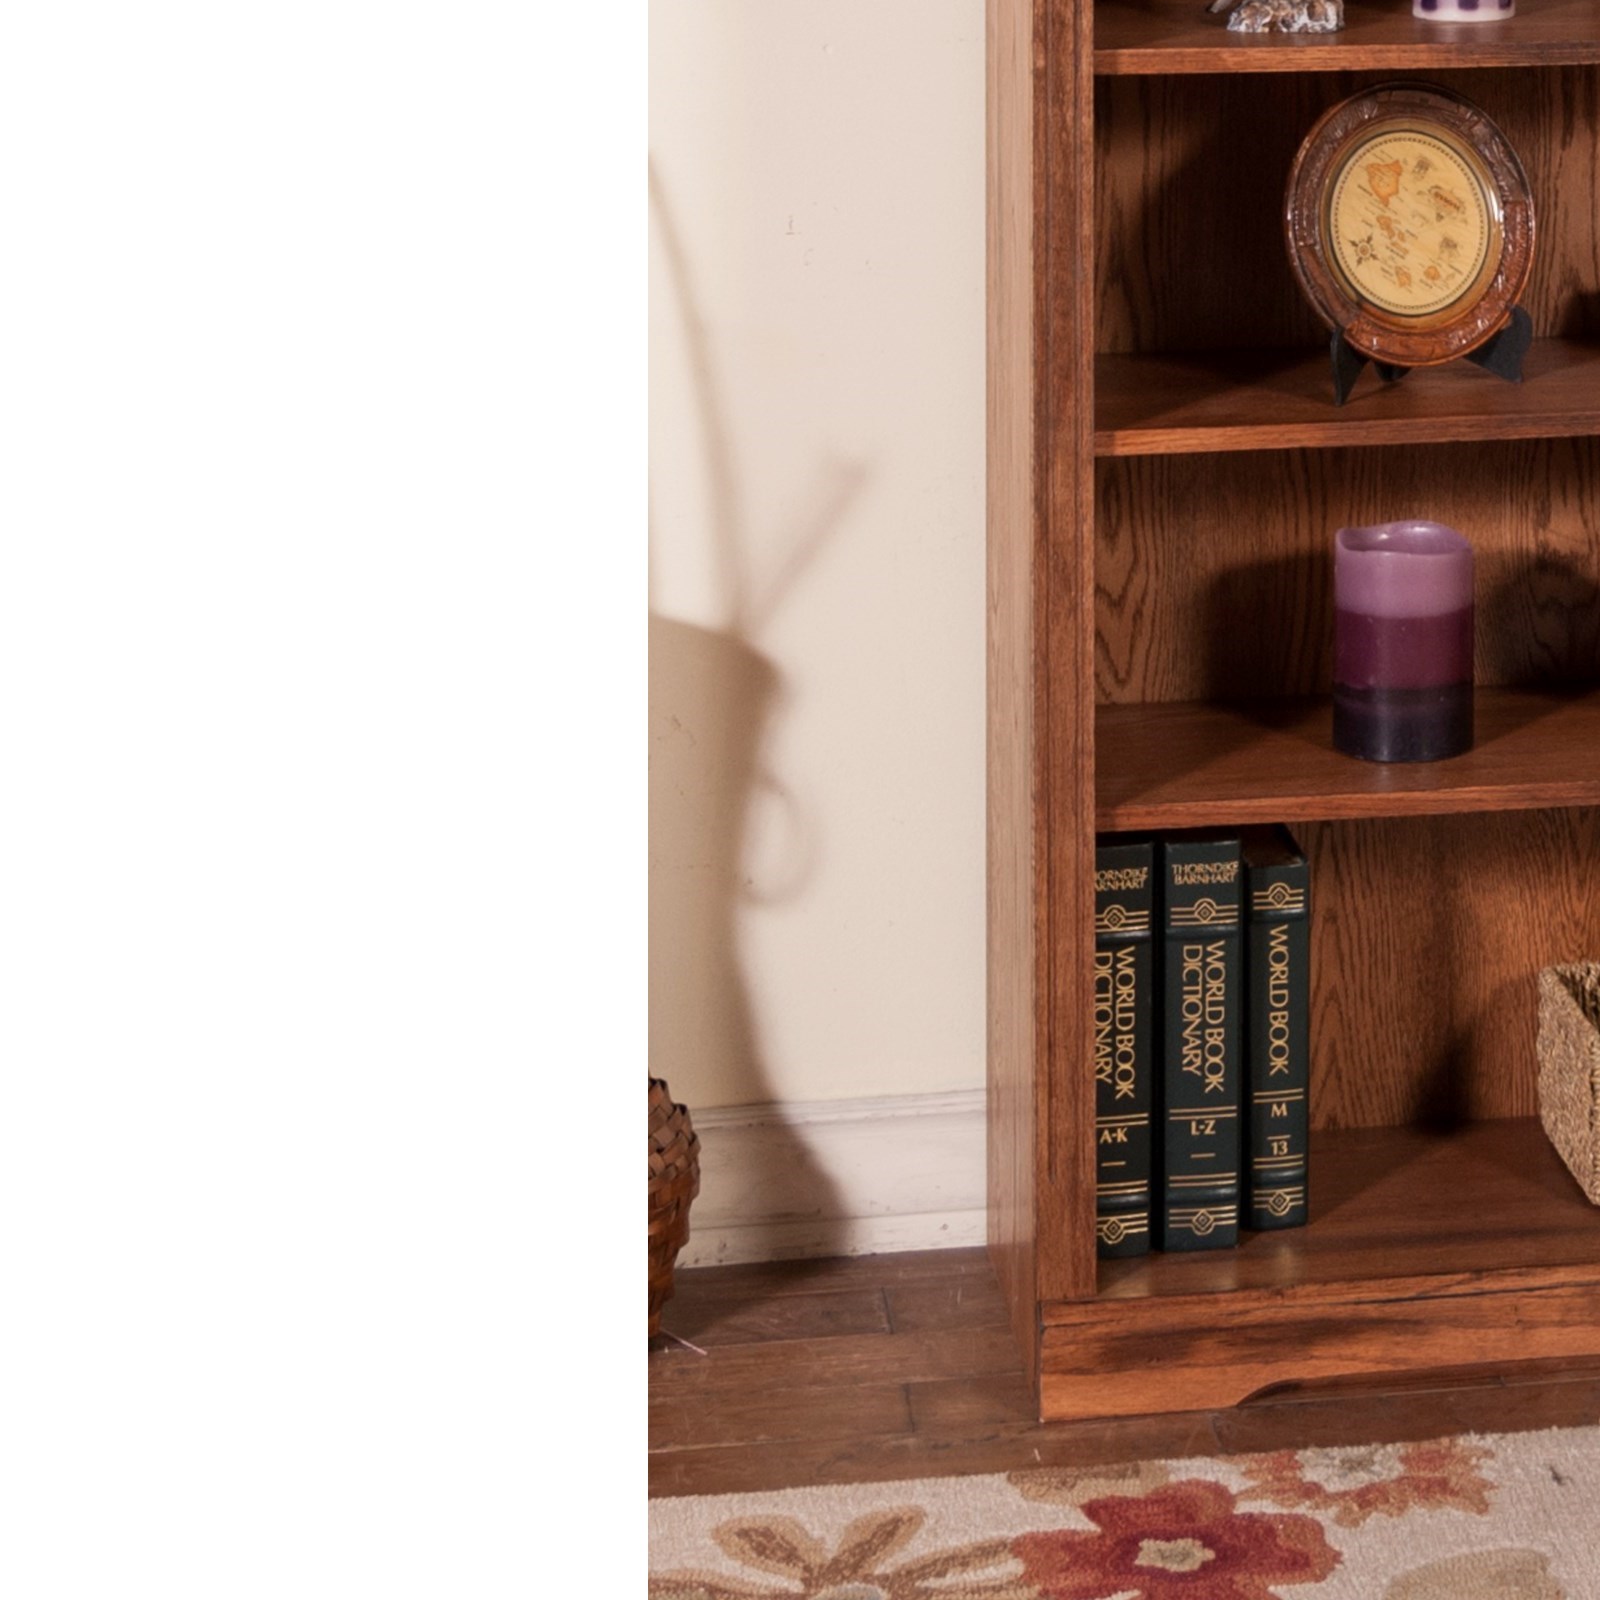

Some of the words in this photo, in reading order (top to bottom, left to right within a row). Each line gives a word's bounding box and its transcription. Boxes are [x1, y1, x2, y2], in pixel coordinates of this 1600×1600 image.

[1172, 861, 1239, 875] THORNDIKE
[1174, 873, 1236, 885] BARNHART
[1115, 946, 1135, 1031] WORLD
[1205, 940, 1226, 1024] WORLD
[1269, 924, 1289, 1007] WORLD
[1096, 952, 1113, 1085] DICTIONARY
[1181, 944, 1203, 1076] DICTIONARY
[1115, 1034, 1135, 1100] BOOK
[1204, 1028, 1225, 1093] BOOK
[1269, 1011, 1289, 1076] BOOK
[1100, 1128, 1128, 1144] A-K
[1190, 1120, 1216, 1136] L-Z
[1271, 1103, 1288, 1118] M
[1271, 1140, 1288, 1155] 13
